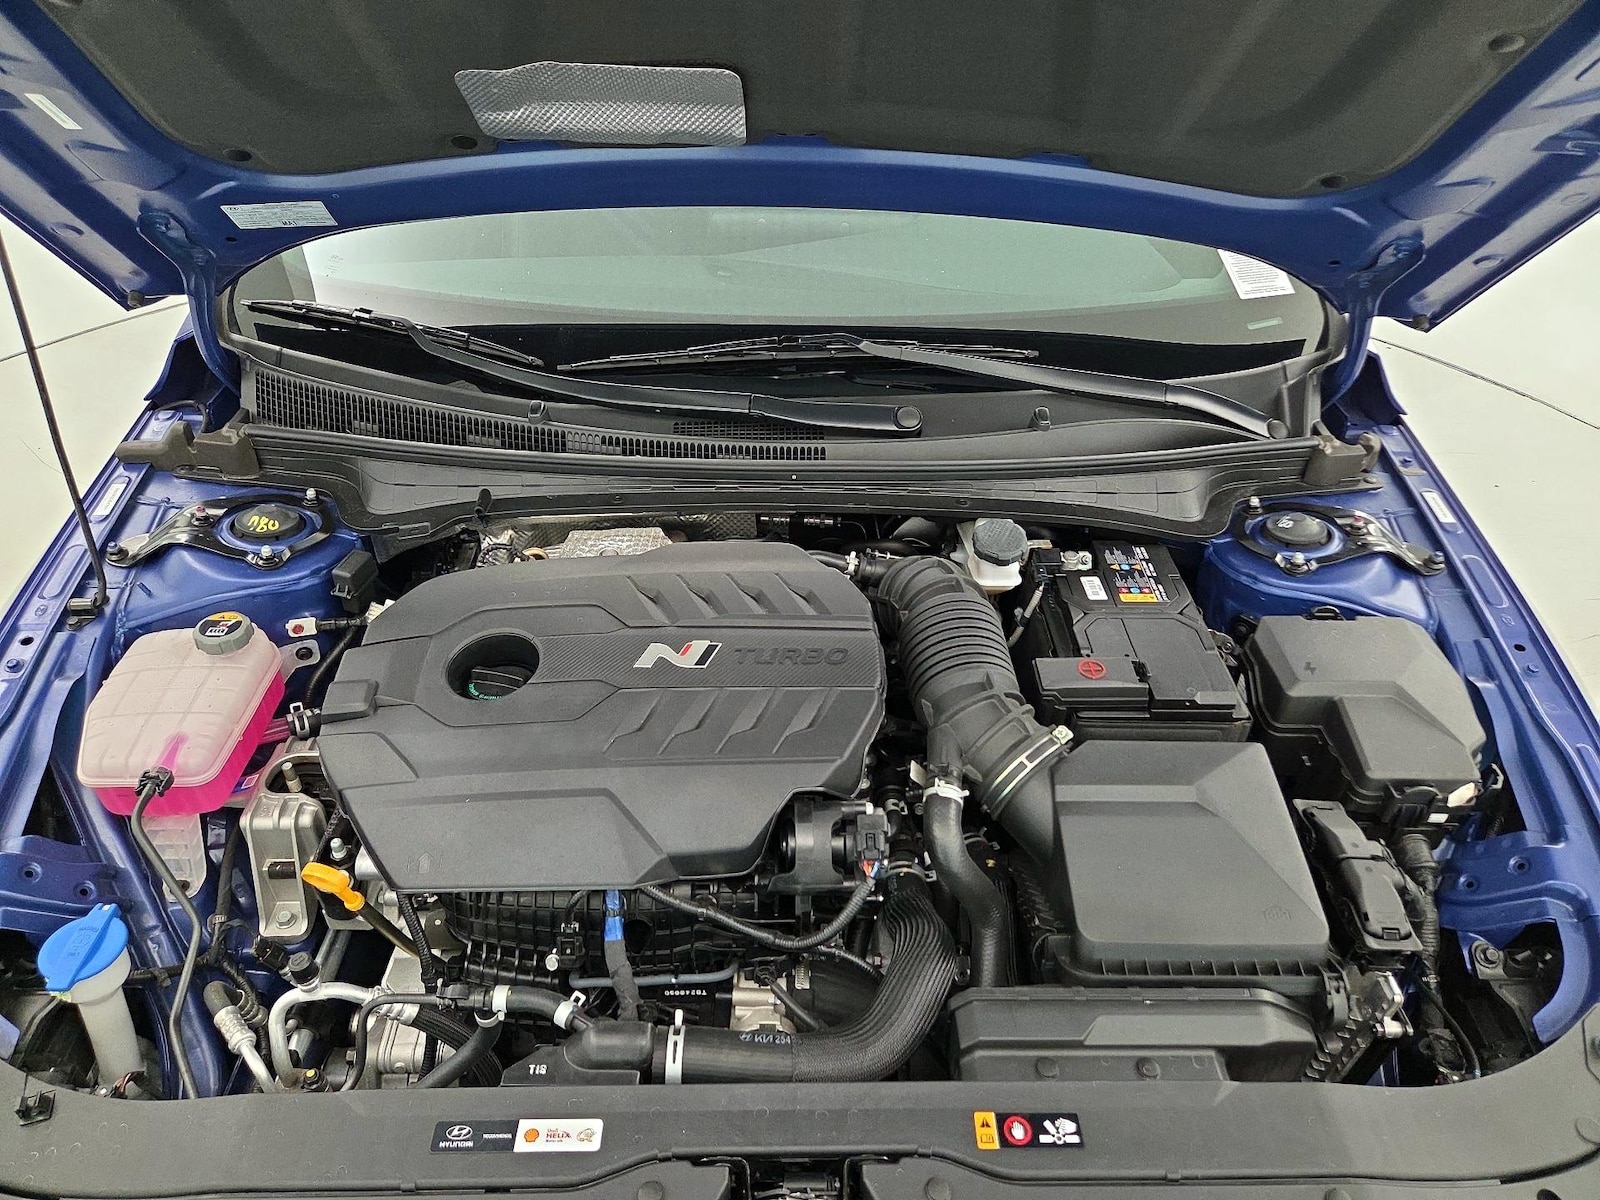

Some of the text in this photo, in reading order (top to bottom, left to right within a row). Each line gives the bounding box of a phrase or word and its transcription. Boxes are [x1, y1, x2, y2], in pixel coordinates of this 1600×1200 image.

[735, 647, 849, 665] TURBO
[546, 1131, 571, 1139] HELIX
[439, 1140, 474, 1148] HYUNDAI
